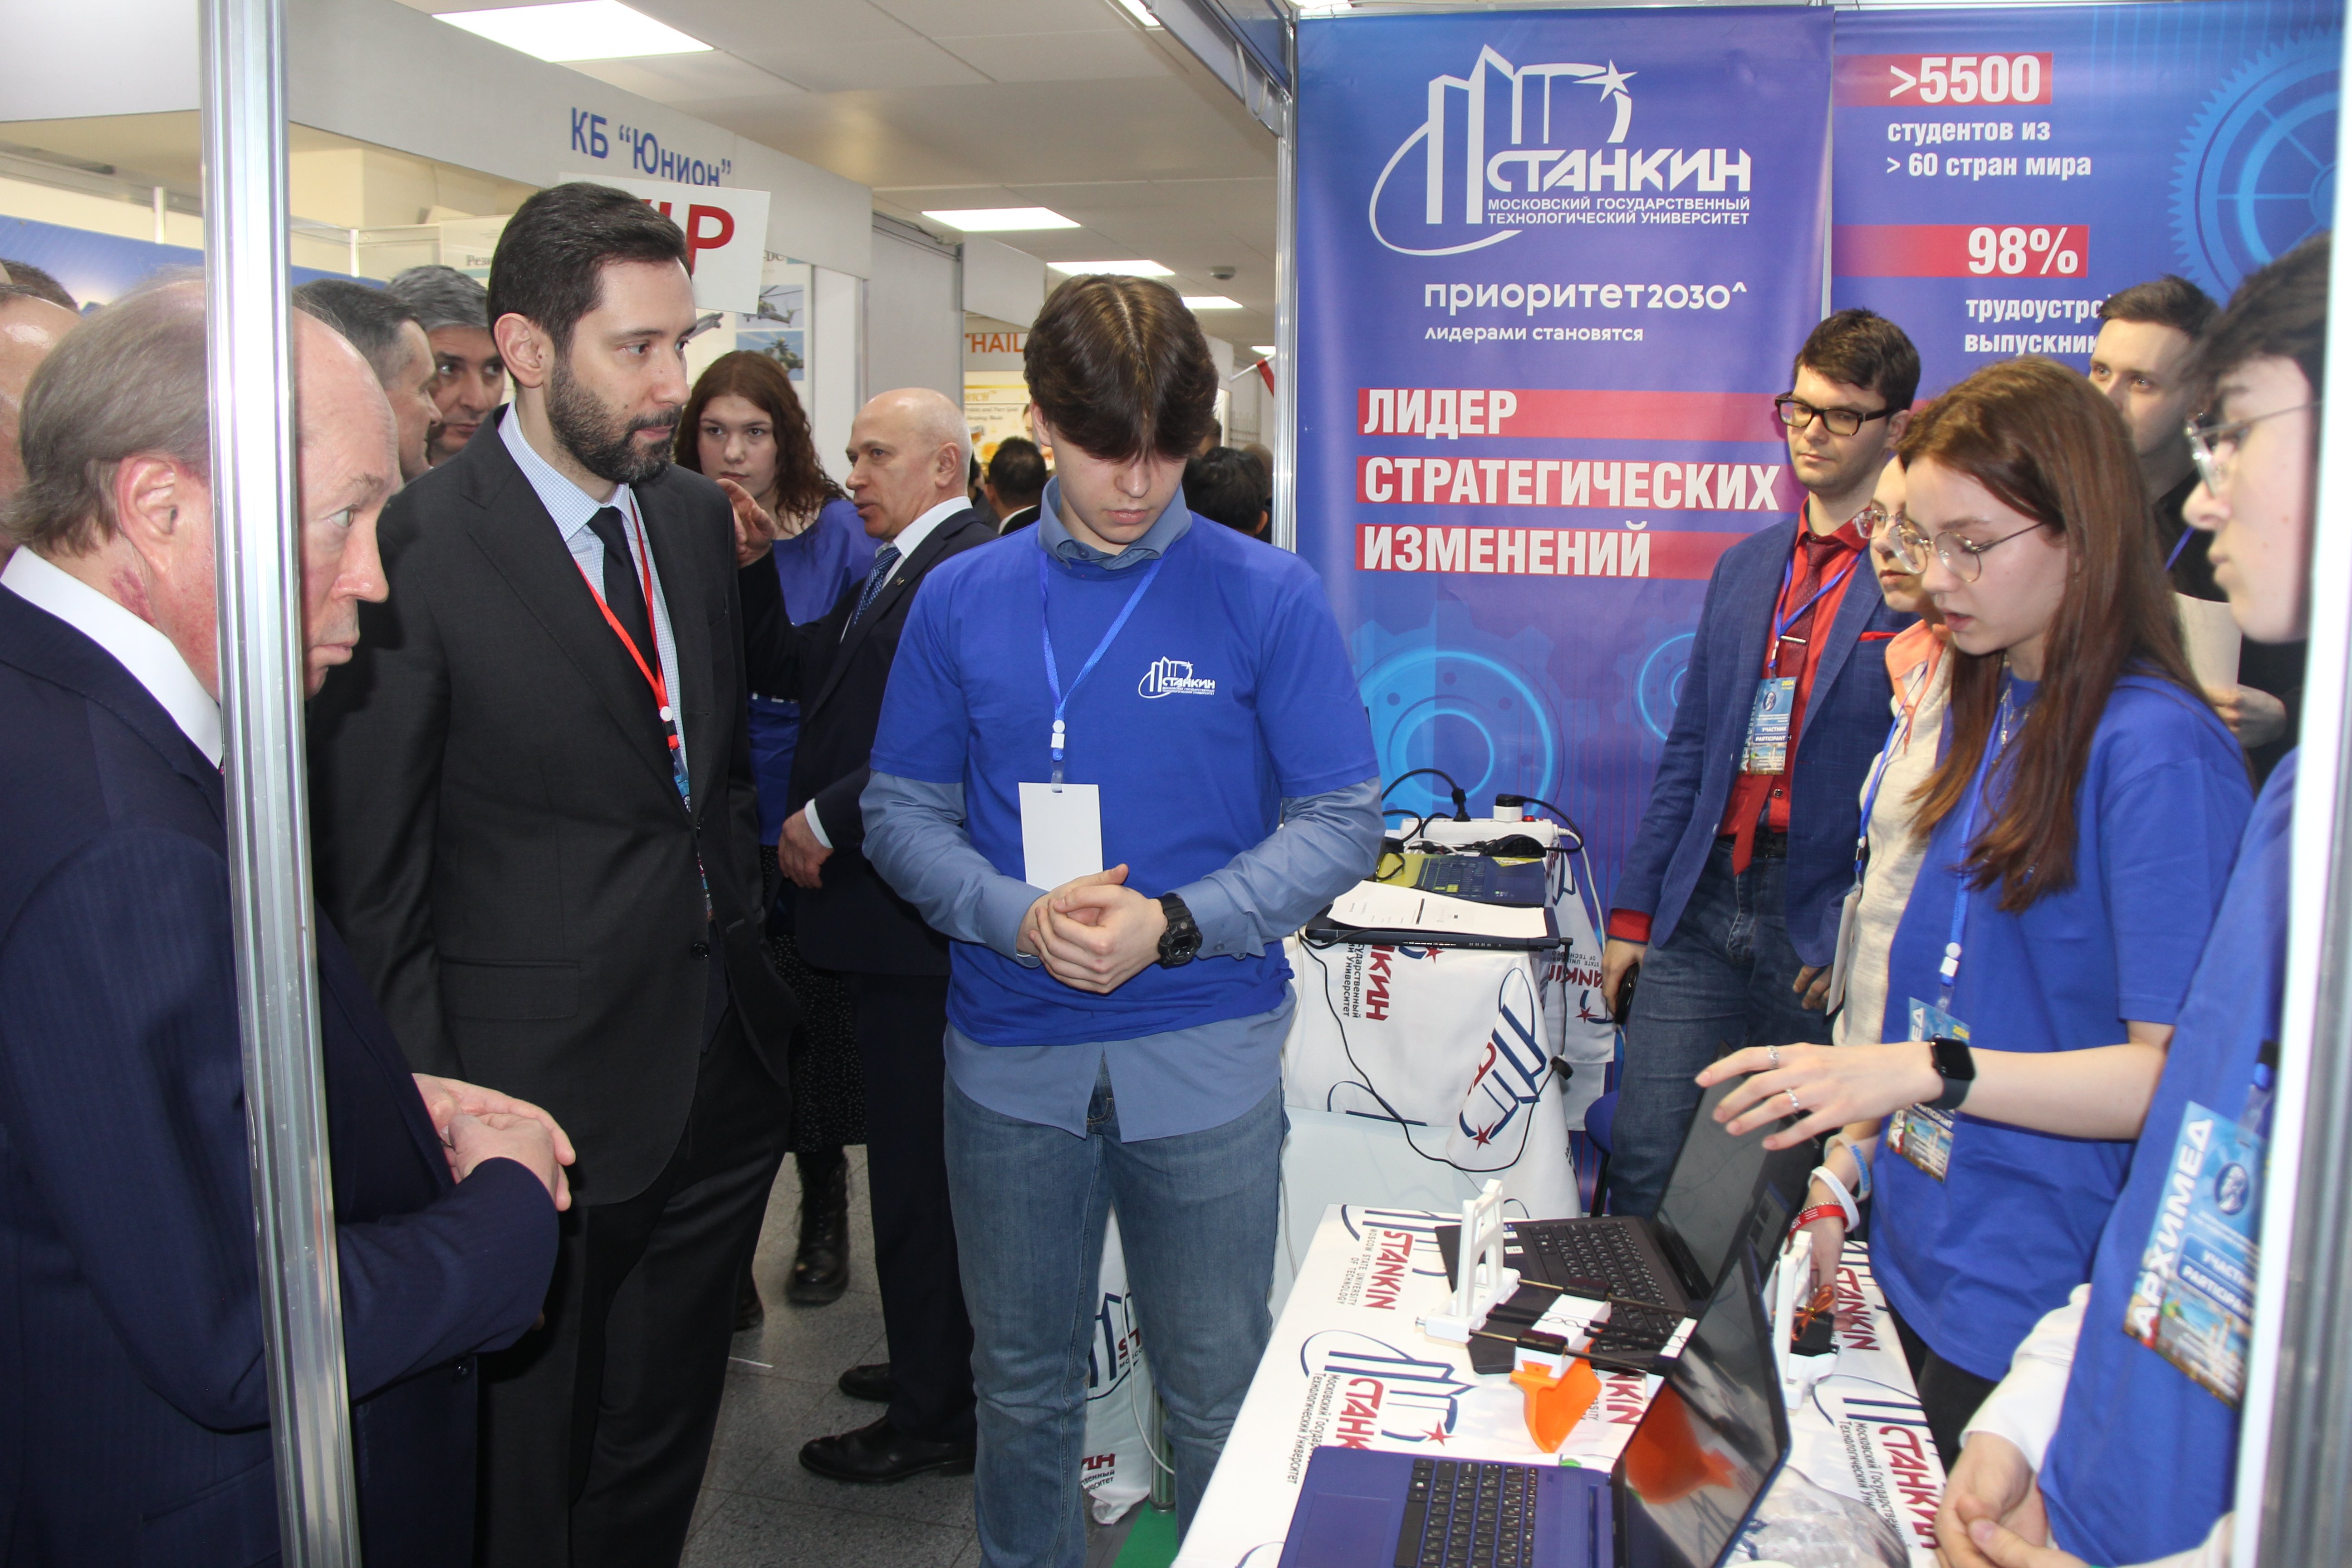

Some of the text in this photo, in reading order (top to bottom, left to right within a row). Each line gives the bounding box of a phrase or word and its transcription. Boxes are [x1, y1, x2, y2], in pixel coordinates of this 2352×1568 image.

[1890, 55, 2040, 103] >5500
[572, 107, 609, 158] КБ
[1888, 122, 2051, 146] студентов из
[1487, 148, 1751, 192] СТАНКИН
[1887, 152, 2092, 181] > 60 стран мира
[1488, 196, 1750, 211] МОСКОВСКИЙ ГОСУДАРСТВЕННЫЙ
[1488, 210, 1749, 225] ТЕХНОЛОГИЧЕСКИЙ УНИВЕРСИТЕТ
[1968, 227, 2078, 274] 98%
[1966, 294, 2112, 323] трудоустро
[965, 333, 1024, 353] HAIL
[1425, 327, 1643, 343] лидерами становятся
[1364, 389, 1517, 439] ЛИДЕР
[1364, 457, 1780, 510] СТРАТЕГИЧЕСКИХ
[1363, 520, 1650, 577] ИЗМЕНЕНИЙ
[1162, 677, 1215, 689] СТАНКИН
[1342, 956, 1355, 1017] Университет
[2134, 1118, 2214, 1338] АРХИМЕД
[1336, 1267, 1357, 1305] TECHNOLOGY
[1348, 1229, 1378, 1306] MOSCOW STATE UNIVERSITY
[1363, 1230, 1413, 1310] STANKIN
[1318, 1373, 1341, 1416] Московский
[1287, 1434, 1310, 1485] Университет
[1839, 1421, 1868, 1488] Технологический
[1855, 1421, 1882, 1469] Московский
